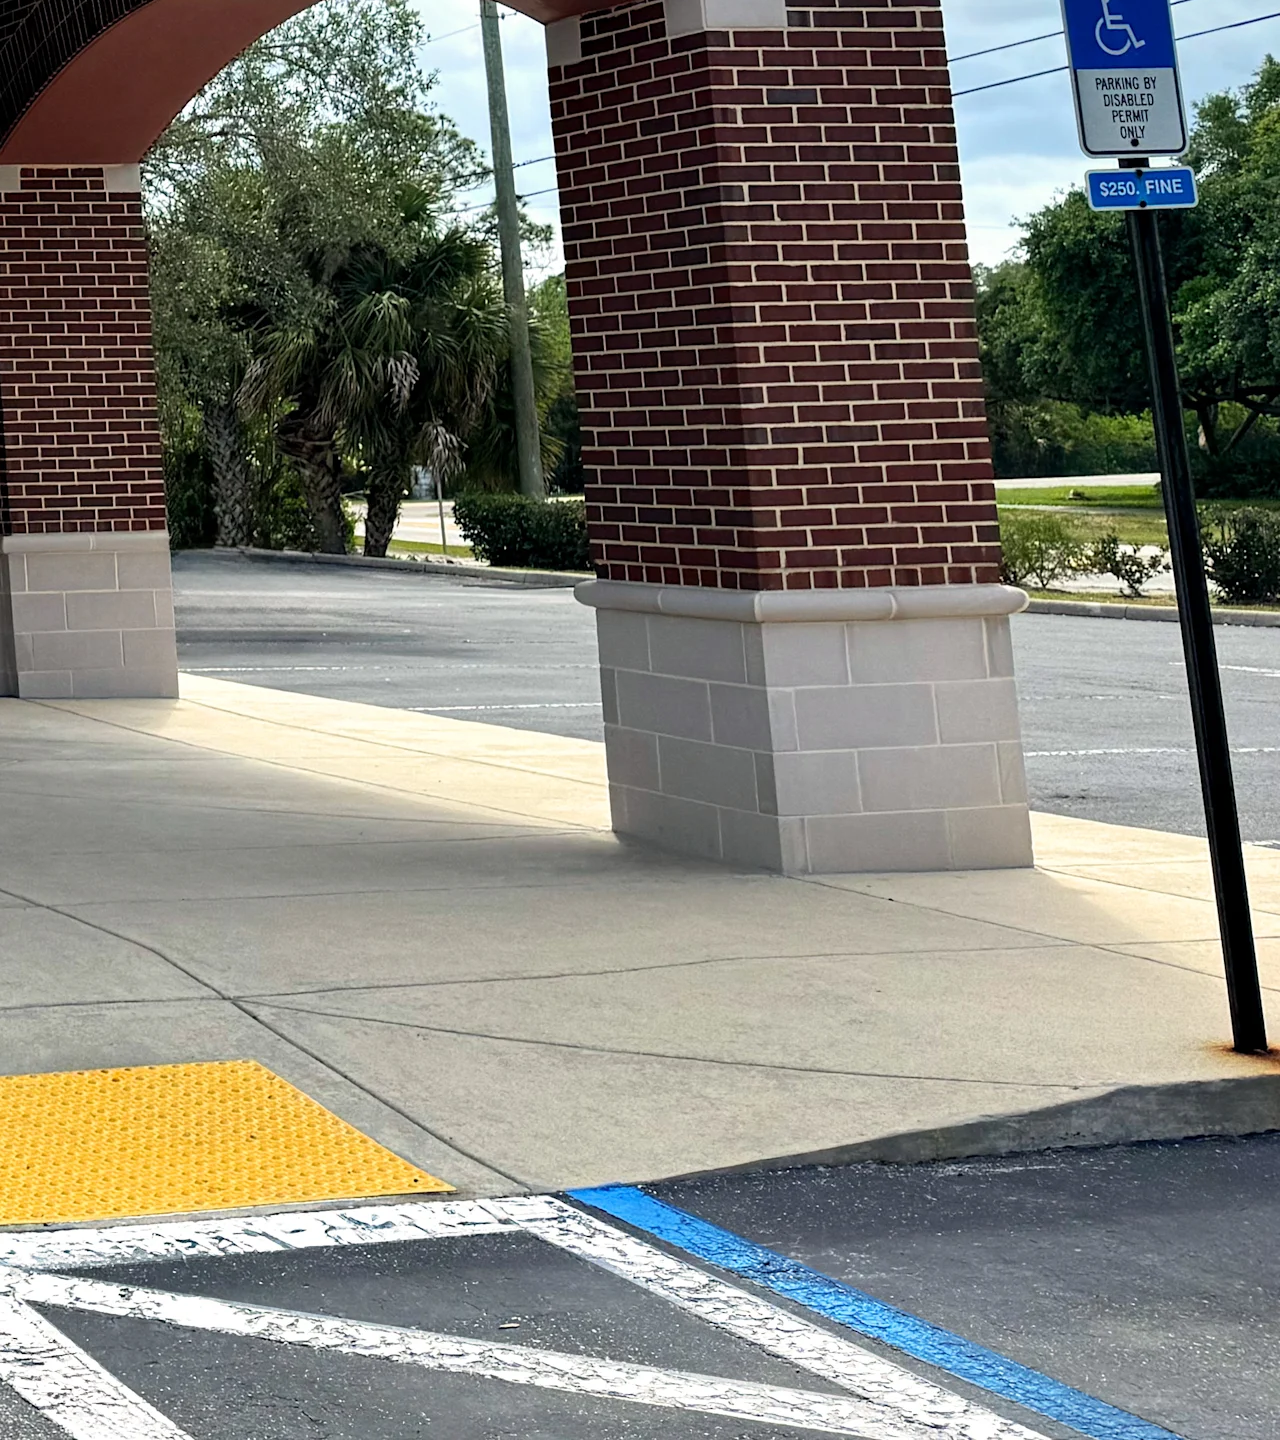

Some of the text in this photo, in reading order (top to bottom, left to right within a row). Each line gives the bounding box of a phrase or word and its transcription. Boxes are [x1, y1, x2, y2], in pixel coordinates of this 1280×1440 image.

[1095, 76, 1157, 91] PARKING BY
[1103, 93, 1155, 107] DISABLED
[1112, 109, 1149, 123] PERMIT
[1120, 125, 1146, 139] ONLY
[1099, 178, 1184, 198] $250. FINE
